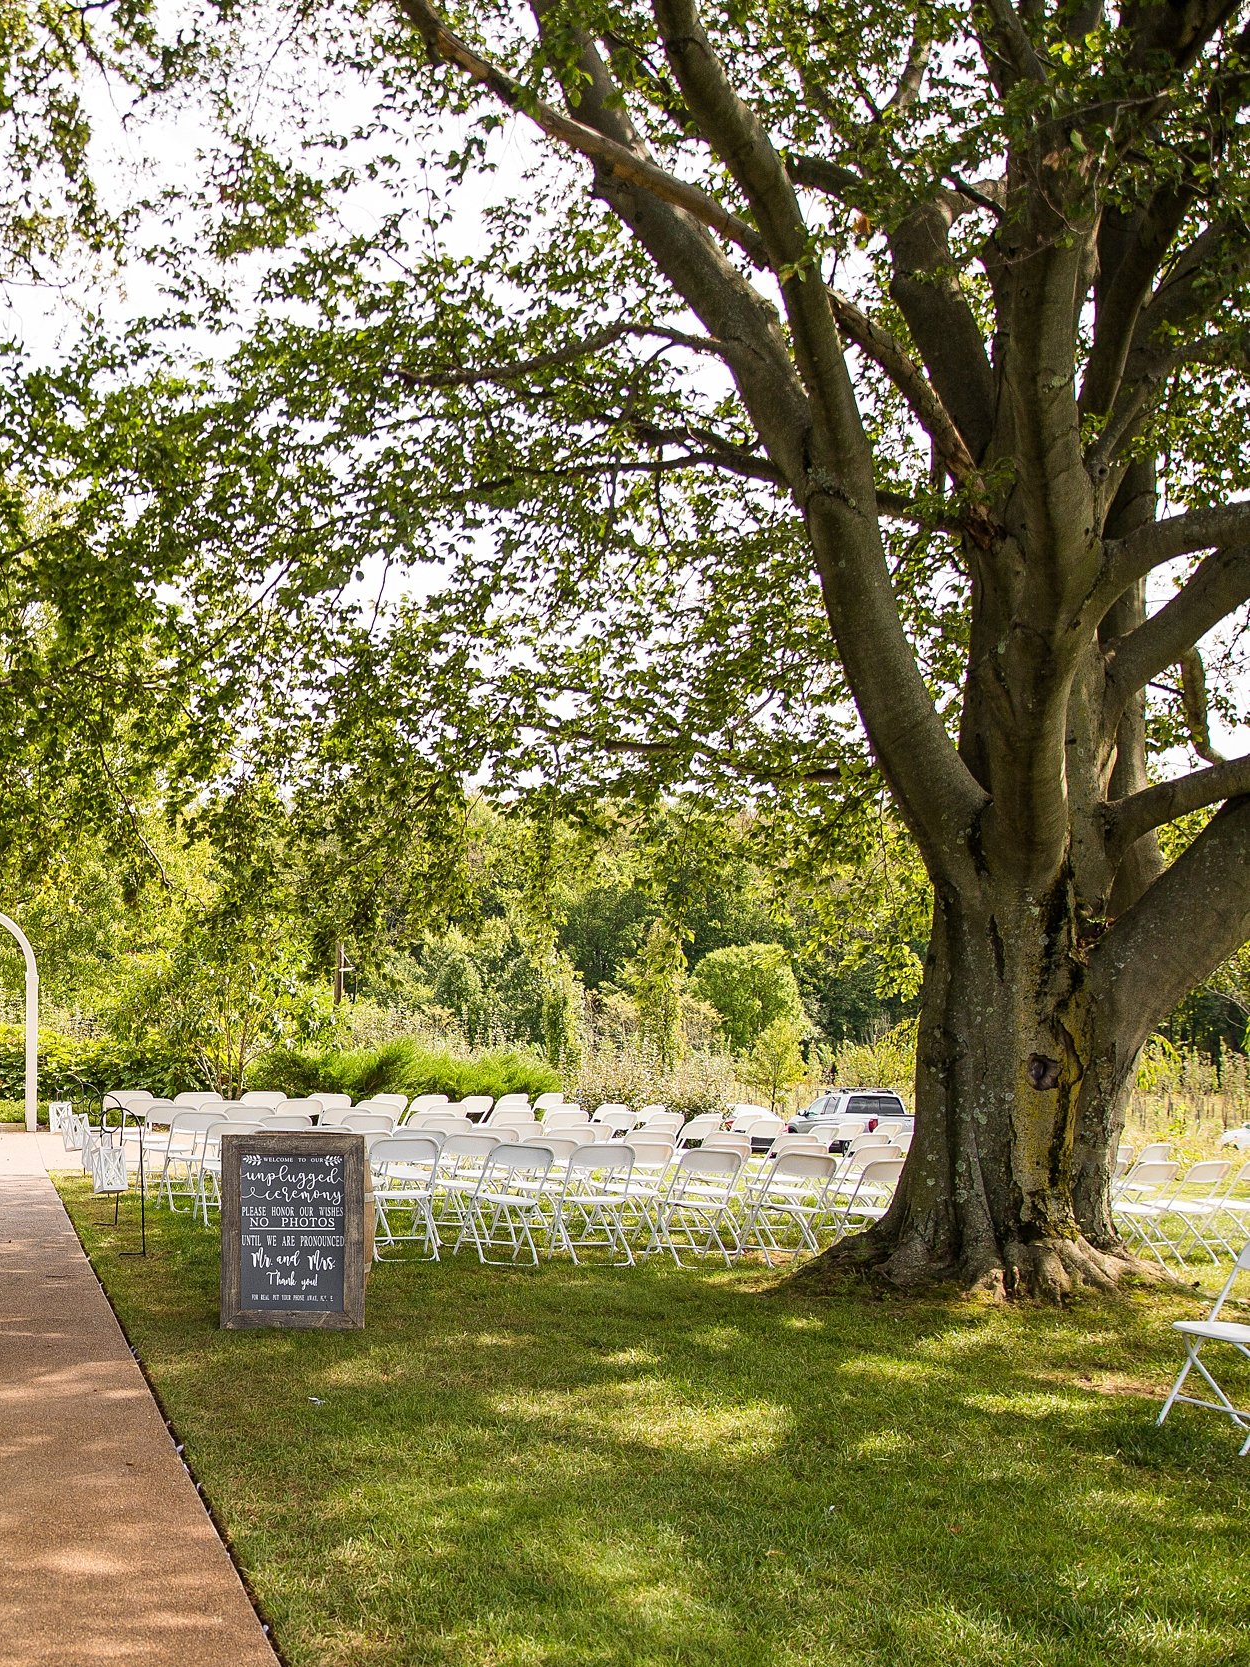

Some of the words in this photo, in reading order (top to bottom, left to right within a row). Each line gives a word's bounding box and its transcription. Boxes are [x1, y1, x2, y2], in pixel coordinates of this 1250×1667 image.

[242, 1165, 344, 1189] unplugged
[242, 1187, 344, 1205] ceremony
[242, 1207, 266, 1216] PLEASE
[272, 1207, 295, 1216] HONOR
[300, 1207, 314, 1216] OUR
[319, 1207, 344, 1217] WISHES
[250, 1217, 269, 1227] NO
[281, 1218, 335, 1227] PHOTOS
[242, 1235, 261, 1246] UNTIL
[266, 1235, 277, 1246] WE
[282, 1236, 295, 1246] ARE
[301, 1236, 345, 1247] PRONOUNCED
[251, 1247, 273, 1268] Mr.
[276, 1250, 300, 1267] and
[307, 1250, 336, 1271] Mrs.
[266, 1269, 297, 1286] Thank
[301, 1273, 318, 1291] you!
